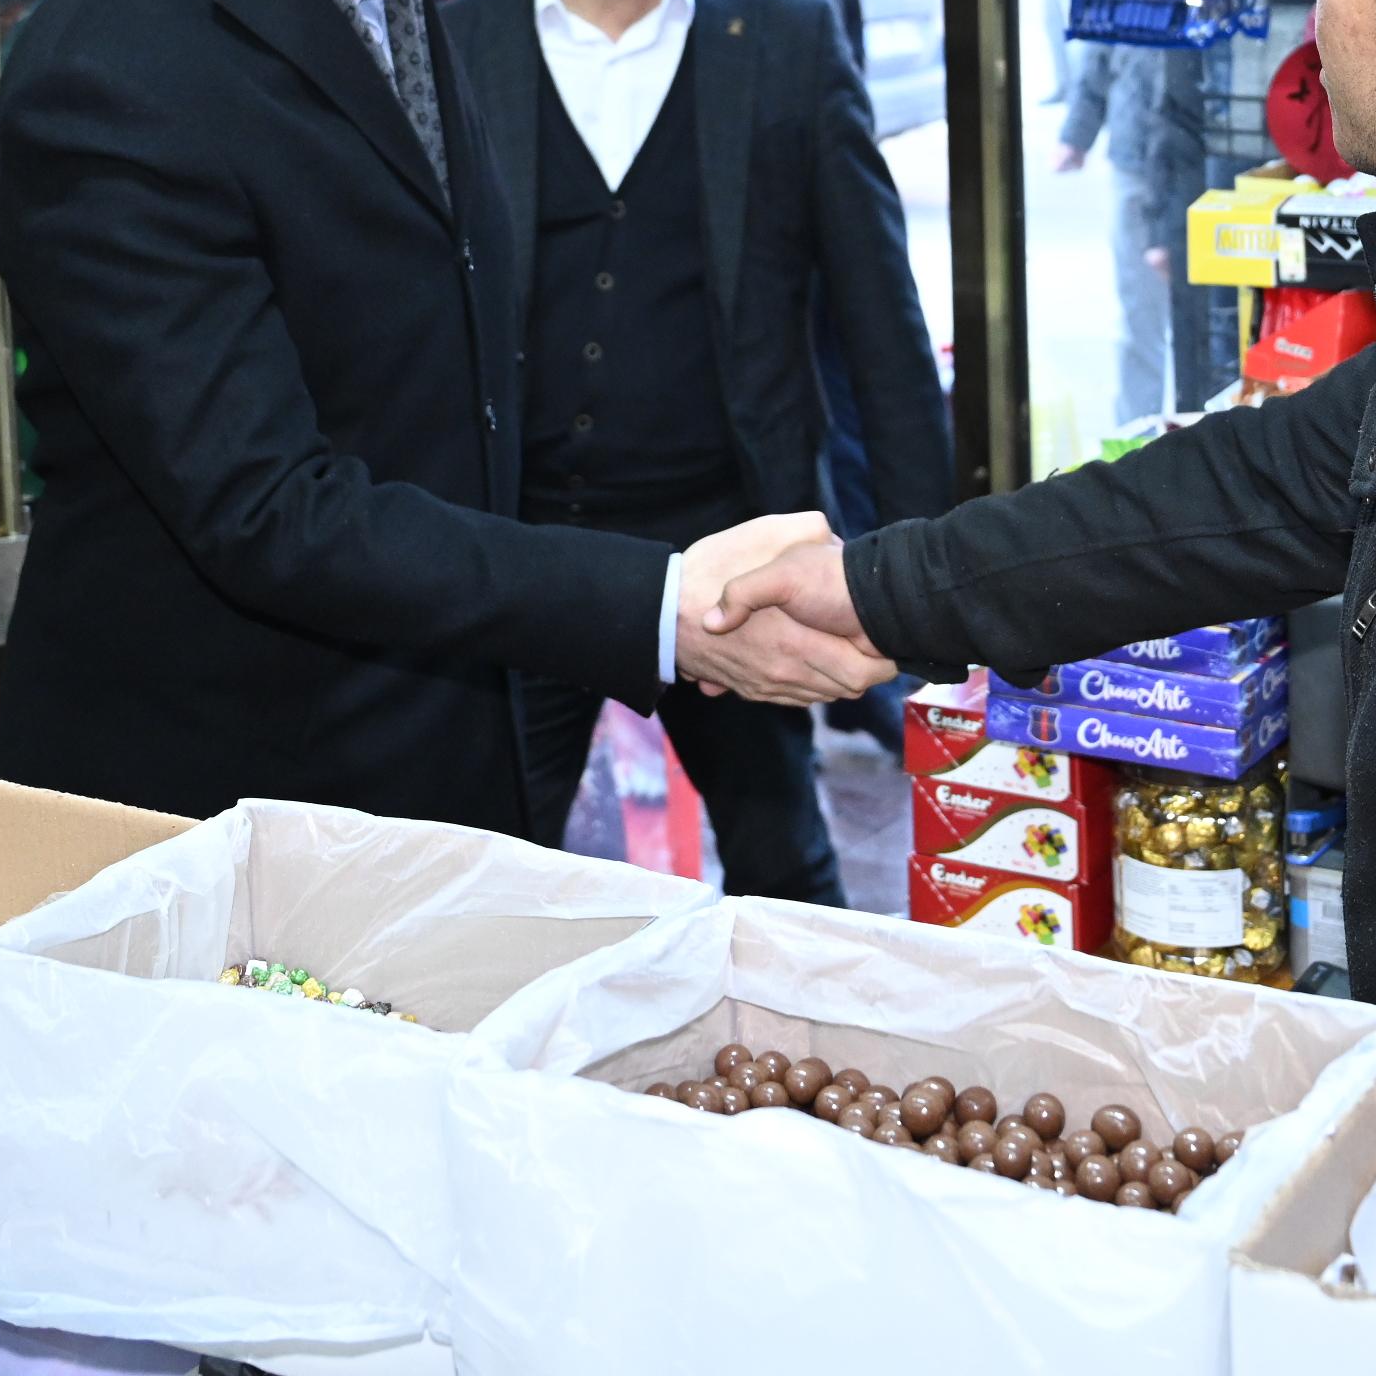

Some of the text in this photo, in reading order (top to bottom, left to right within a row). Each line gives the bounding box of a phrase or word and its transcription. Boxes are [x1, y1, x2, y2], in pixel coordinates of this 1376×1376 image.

[1079, 670, 1192, 711] ChocoArte
[928, 707, 983, 732] Ender
[1077, 717, 1189, 760] ChocoArte
[935, 784, 992, 811] Ender
[930, 863, 986, 889] Ender
